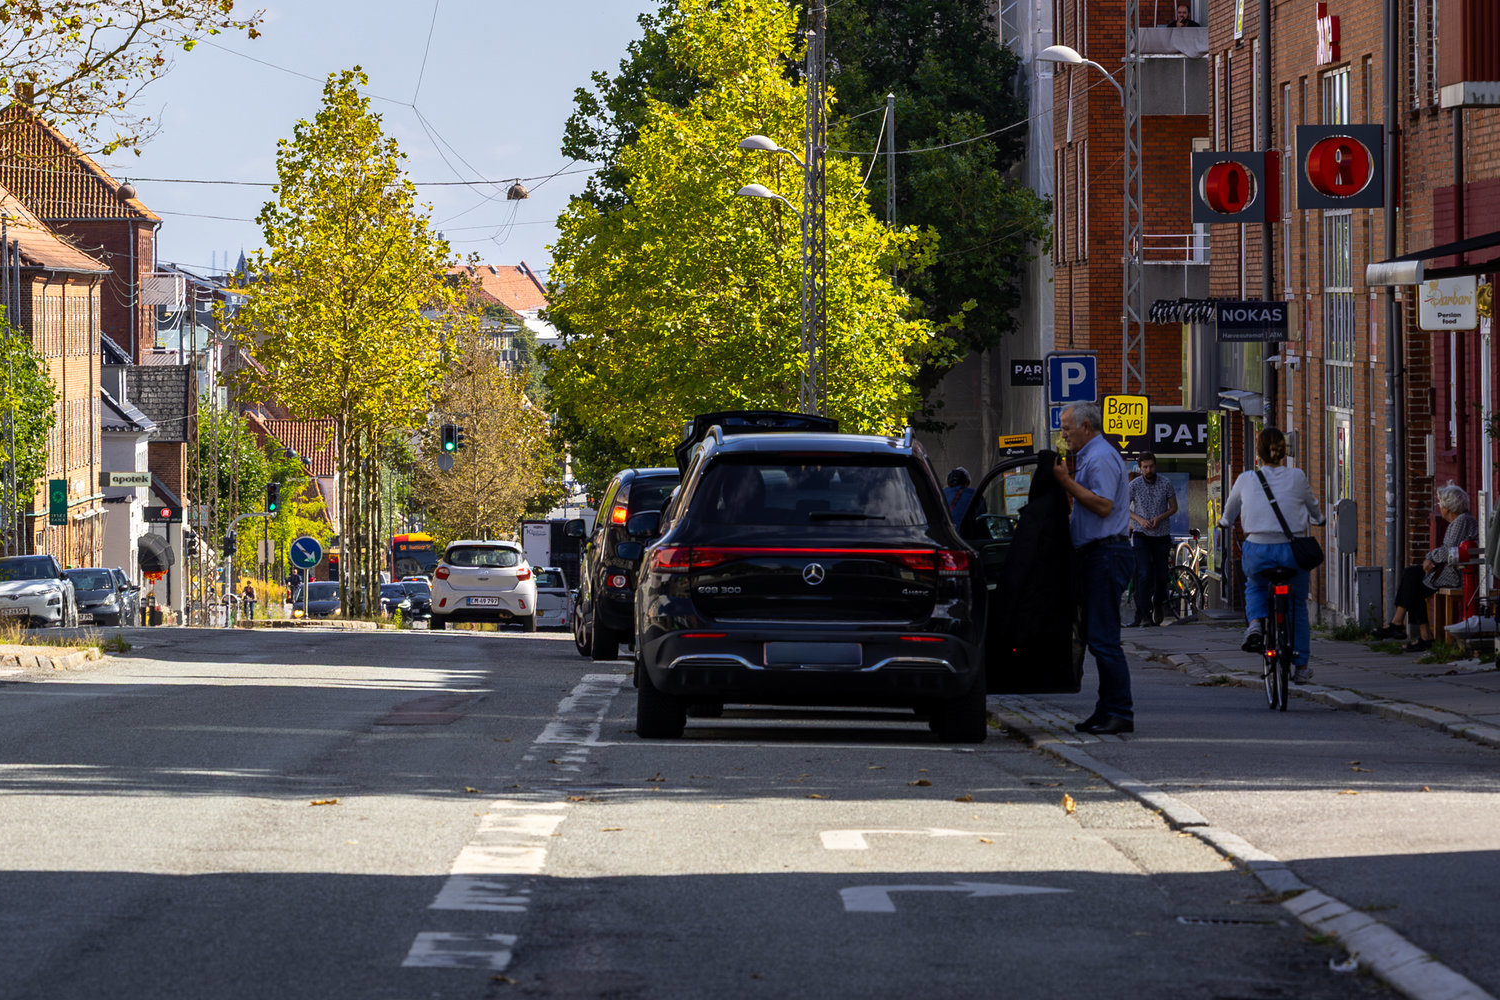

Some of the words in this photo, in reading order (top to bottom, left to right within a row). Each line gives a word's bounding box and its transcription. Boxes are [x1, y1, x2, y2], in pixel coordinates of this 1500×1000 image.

[1222, 309, 1283, 321] NOKAS
[1061, 362, 1087, 398] P
[1108, 398, 1143, 415] Børn
[1108, 415, 1123, 432] på
[1126, 417, 1143, 433] vej
[112, 475, 149, 484] apotek
[721, 586, 742, 594] 300
